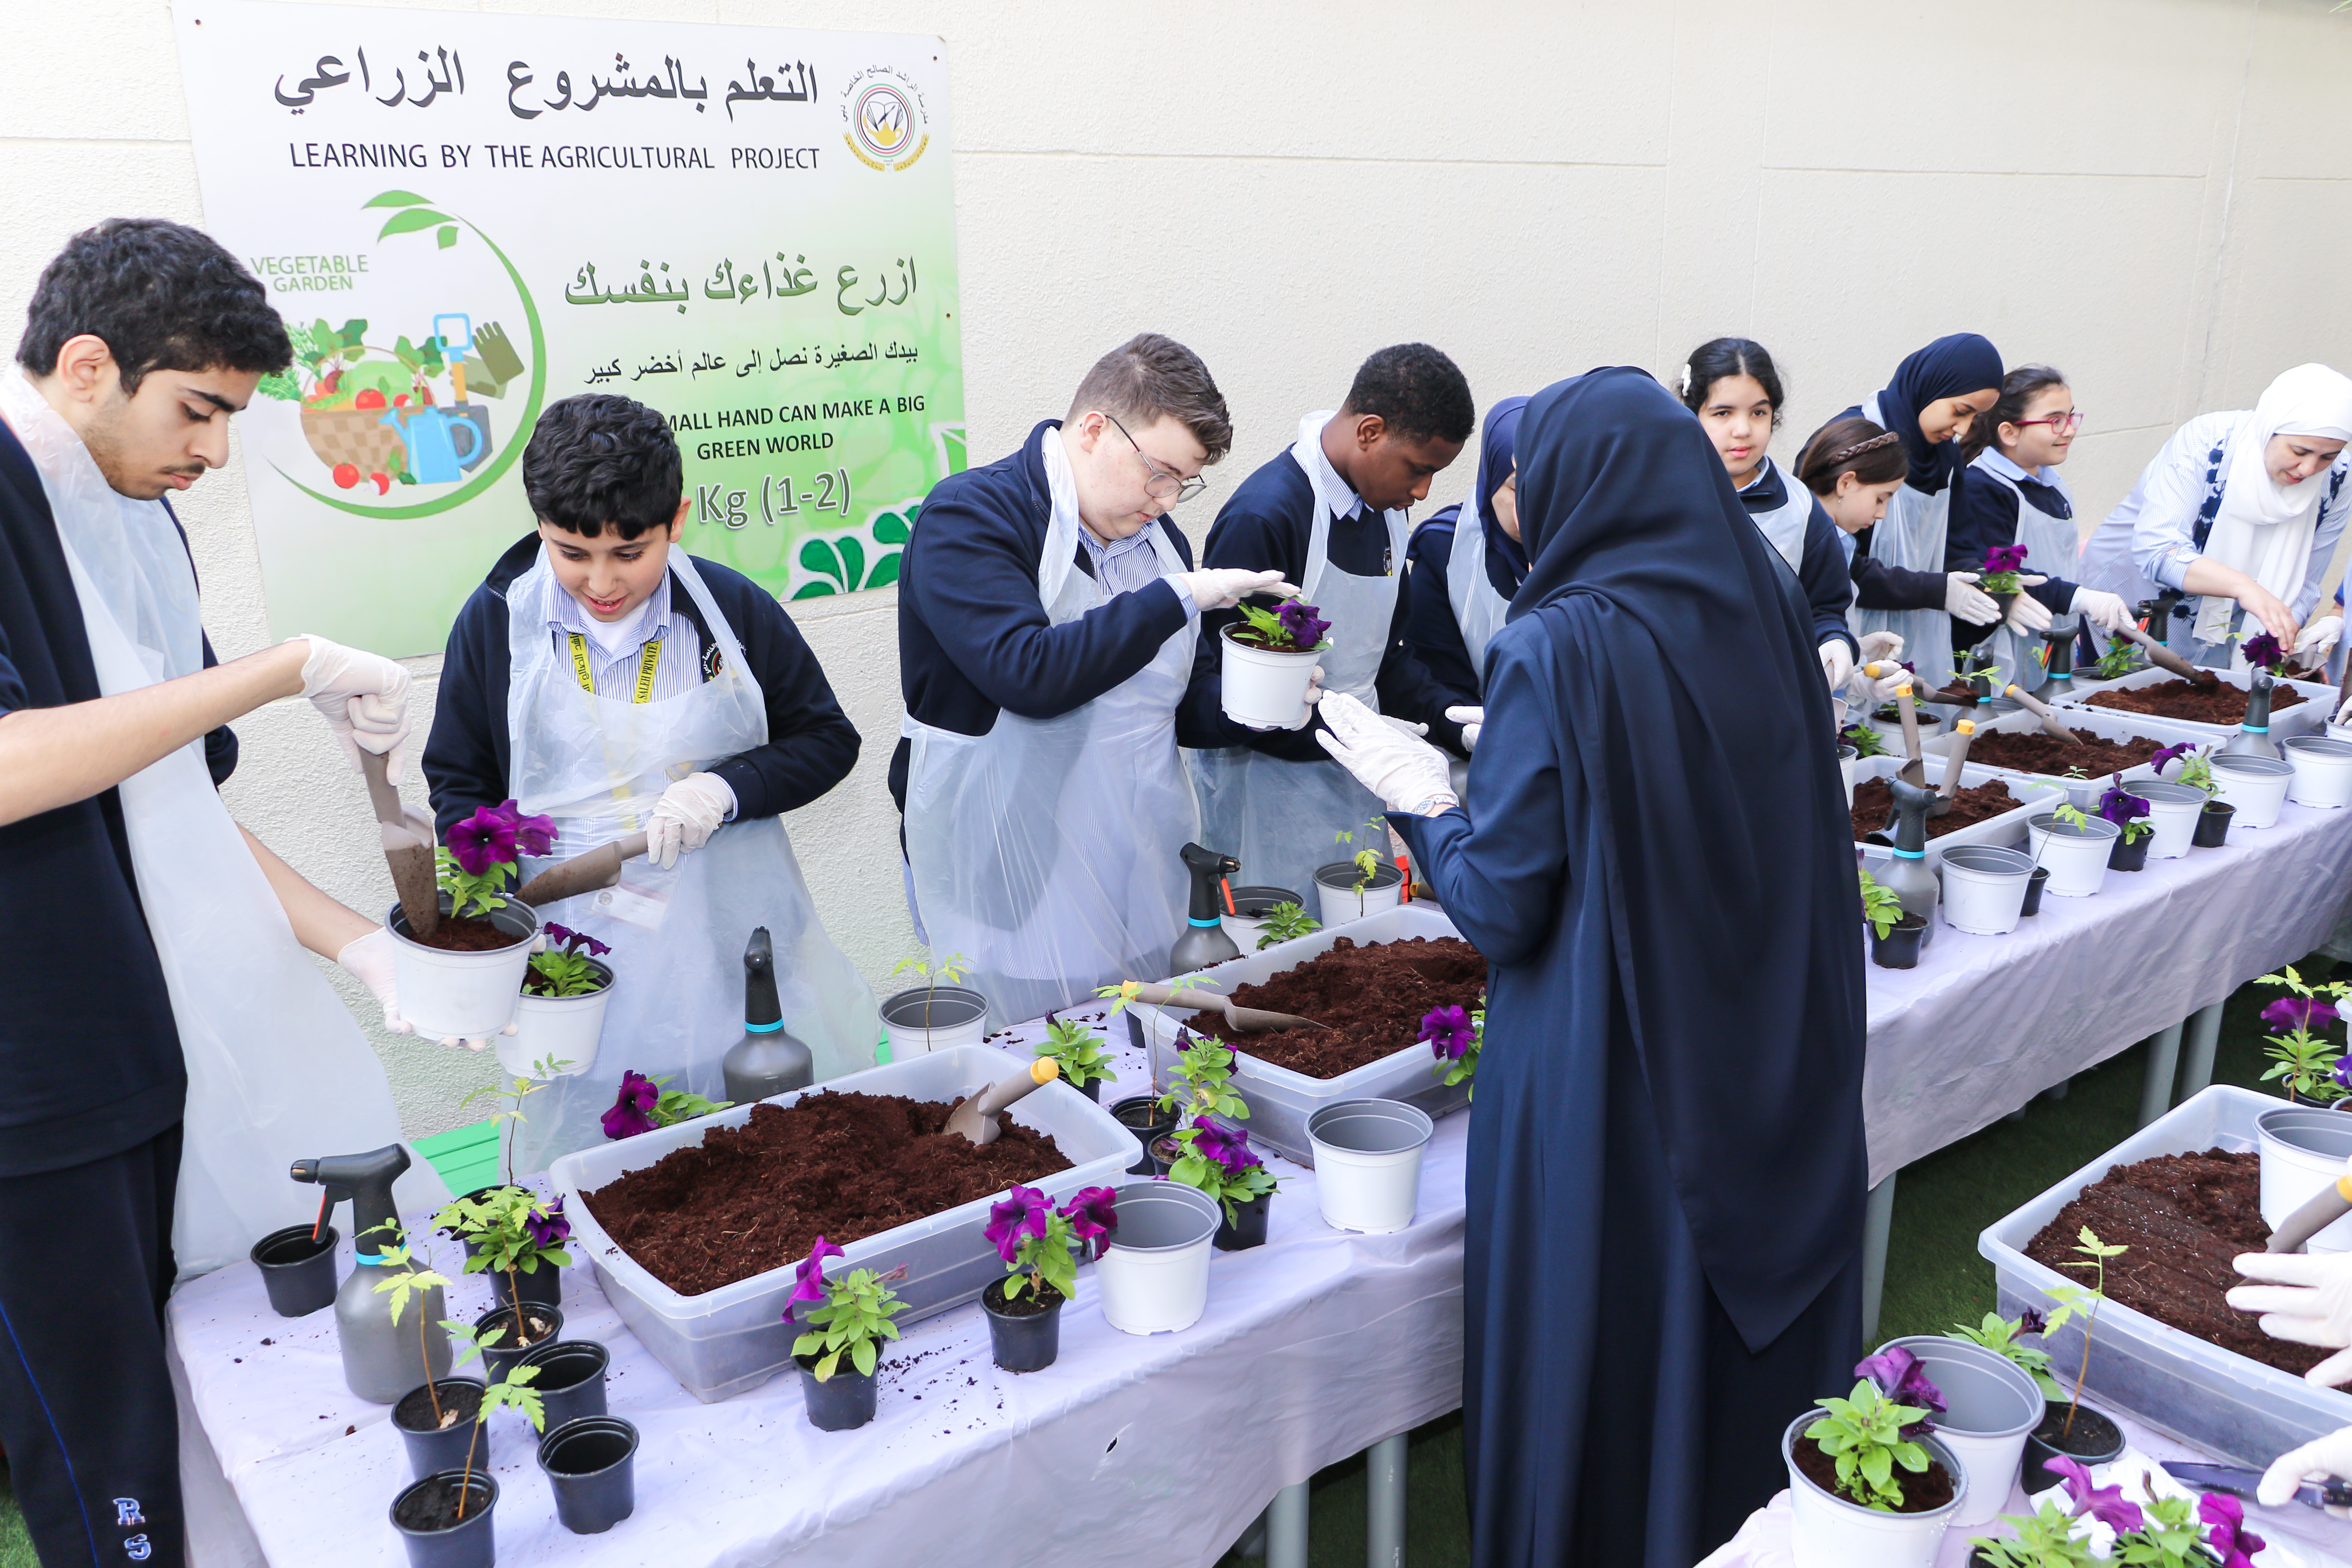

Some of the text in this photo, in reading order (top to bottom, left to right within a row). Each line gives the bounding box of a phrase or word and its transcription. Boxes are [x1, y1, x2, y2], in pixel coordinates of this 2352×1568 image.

[275, 45, 818, 122] التعلم بالمشروع الزراعي
[840, 70, 864, 99] الخاصة
[866, 64, 893, 78] الصالح
[895, 70, 919, 92] الراشد
[918, 92, 929, 124] مدرسة
[290, 143, 820, 169] LEARNING BY THE AGRICULTURAL PROJECT
[250, 255, 369, 275] VEGETABLE
[273, 276, 353, 292] GARDEN
[565, 250, 917, 315] ازرع غذاءك بنفسك
[583, 340, 918, 384] بيدك الصغيرة نصل إلى عالم أخضر كبير
[717, 407, 774, 428] HAND
[779, 404, 817, 423] CAN
[823, 399, 874, 419] MAKE
[879, 398, 891, 415] A
[897, 395, 925, 413] BIG
[697, 432, 834, 460] GREEN WORLD
[697, 468, 851, 529] Kg (1-2)
[574, 653, 590, 680] الصالح
[642, 644, 658, 675] PRIVATE
[637, 675, 651, 700] SALEH
